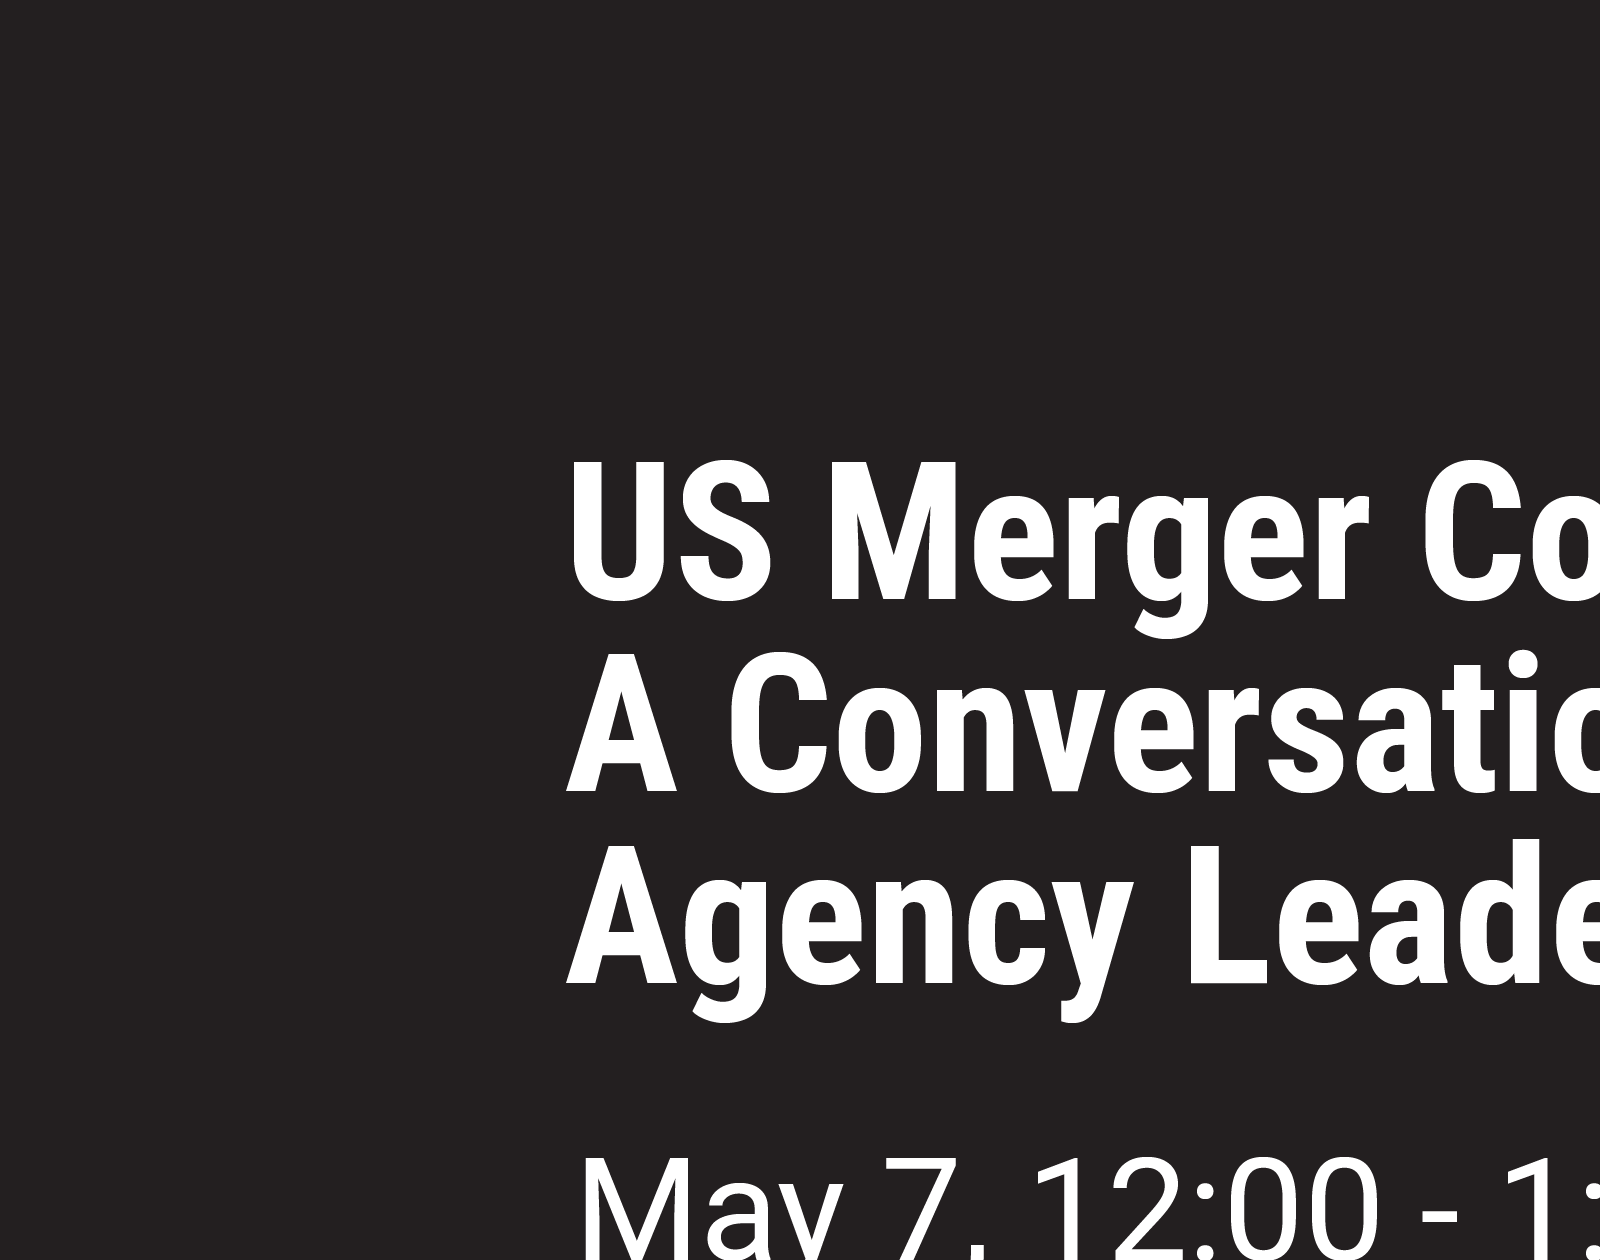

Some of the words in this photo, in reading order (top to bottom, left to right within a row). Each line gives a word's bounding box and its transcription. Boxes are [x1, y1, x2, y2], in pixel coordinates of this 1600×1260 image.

[574, 460, 770, 601] US
[832, 462, 1369, 640] Merger
[566, 654, 677, 791] A
[566, 846, 1134, 1023] Agency
[1038, 1157, 1377, 1260] 12:00
[1422, 1211, 1457, 1222] -
